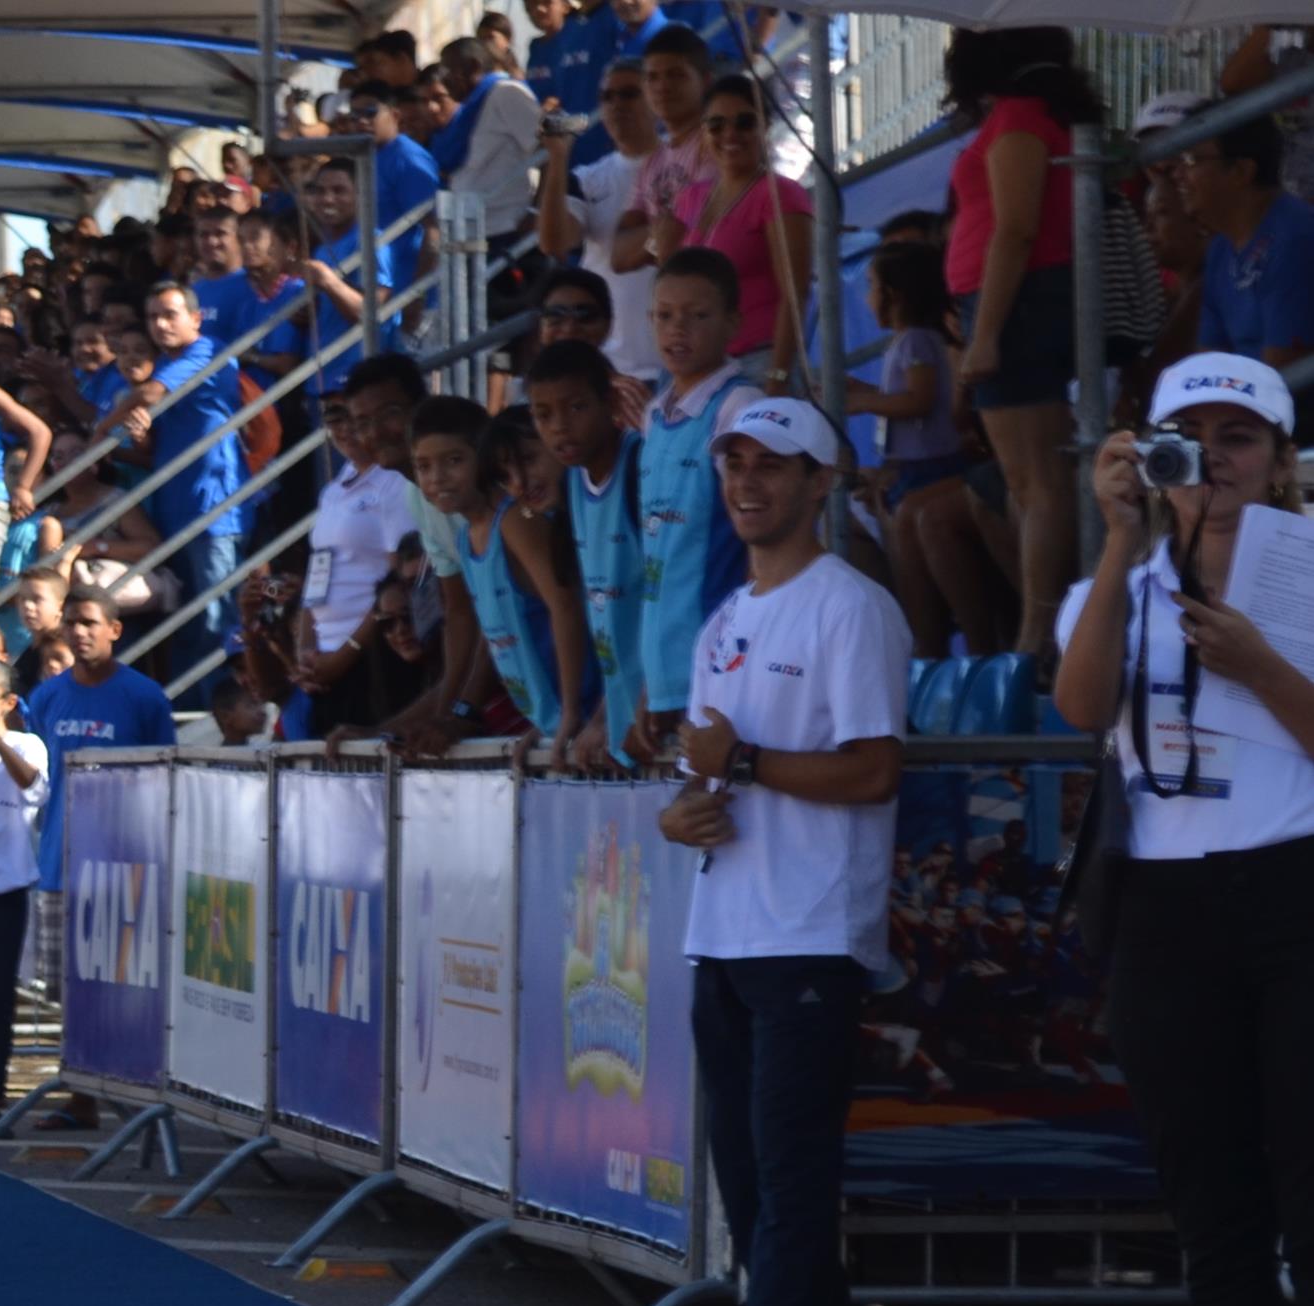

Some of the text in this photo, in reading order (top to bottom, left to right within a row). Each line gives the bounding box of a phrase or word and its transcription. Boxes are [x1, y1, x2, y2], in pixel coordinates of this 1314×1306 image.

[1183, 376, 1254, 397] CAIXA
[742, 411, 791, 429] CAIXA
[766, 662, 804, 677] CAIXA
[54, 719, 115, 741] CAIXA
[75, 858, 159, 990] CAIXA
[290, 880, 370, 1024] CAIXA
